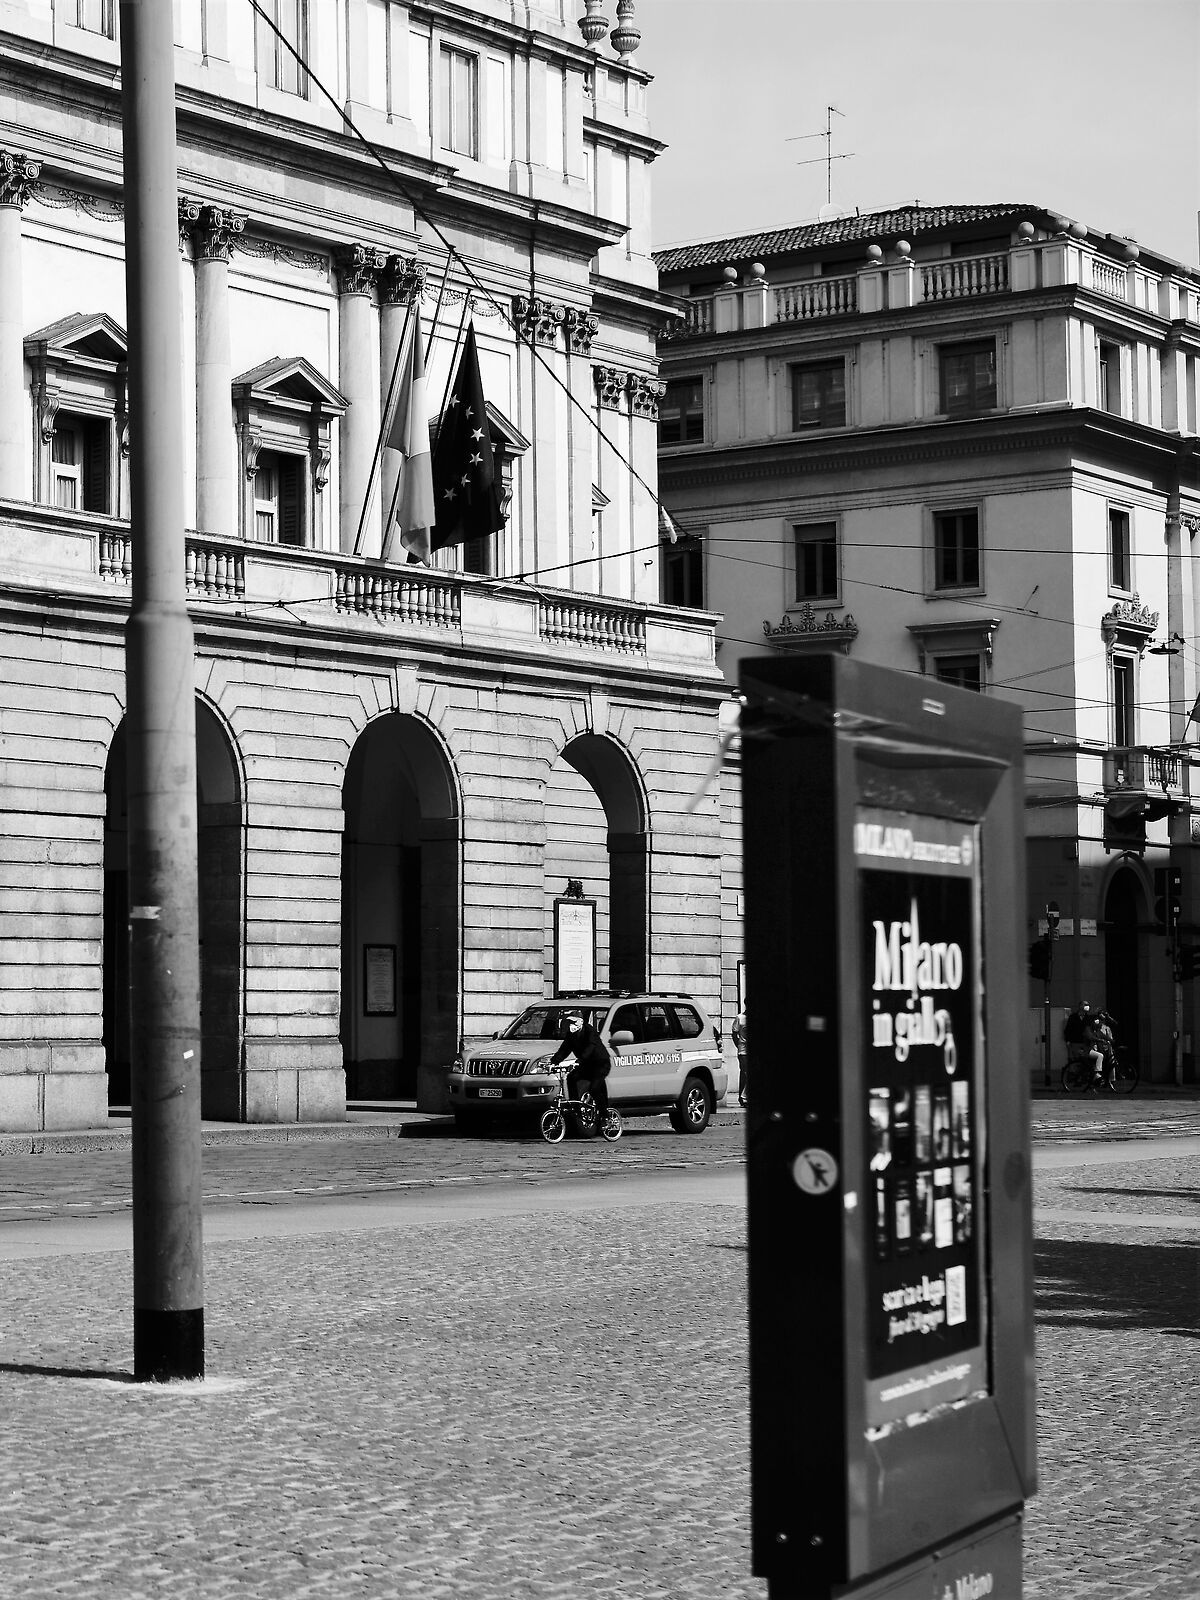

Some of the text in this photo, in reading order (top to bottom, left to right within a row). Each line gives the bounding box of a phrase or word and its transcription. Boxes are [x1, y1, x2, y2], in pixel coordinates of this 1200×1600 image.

[872, 897, 962, 1000] Milano
[872, 999, 893, 1047] in
[613, 1053, 680, 1067] VIGILI DEL FUOCO 115
